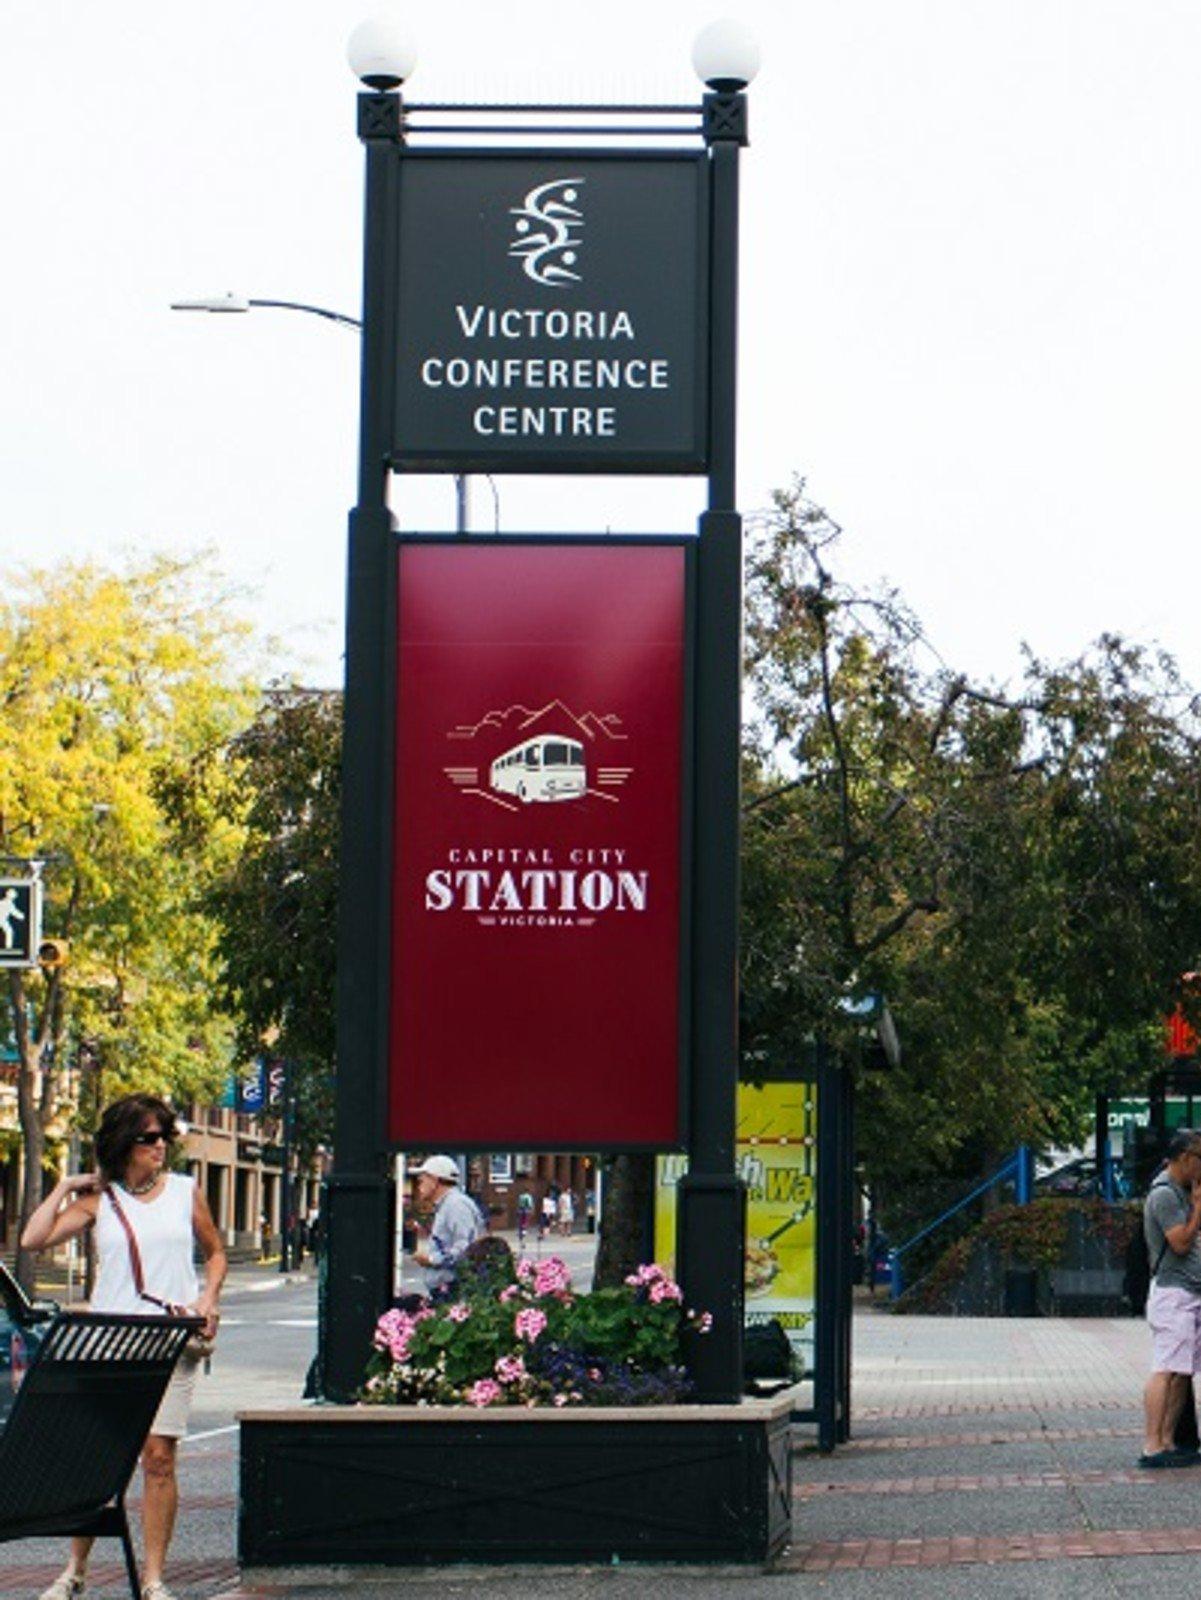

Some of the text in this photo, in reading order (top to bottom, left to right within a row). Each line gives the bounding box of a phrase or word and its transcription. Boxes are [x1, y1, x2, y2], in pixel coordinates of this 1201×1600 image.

[455, 304, 635, 339] VICTORIA
[421, 358, 670, 389] CONFERENCE
[472, 406, 617, 436] CENTRE
[449, 849, 627, 863] CAPITAL CITY
[425, 869, 649, 911] STATION
[499, 916, 575, 926] VICTORIA
